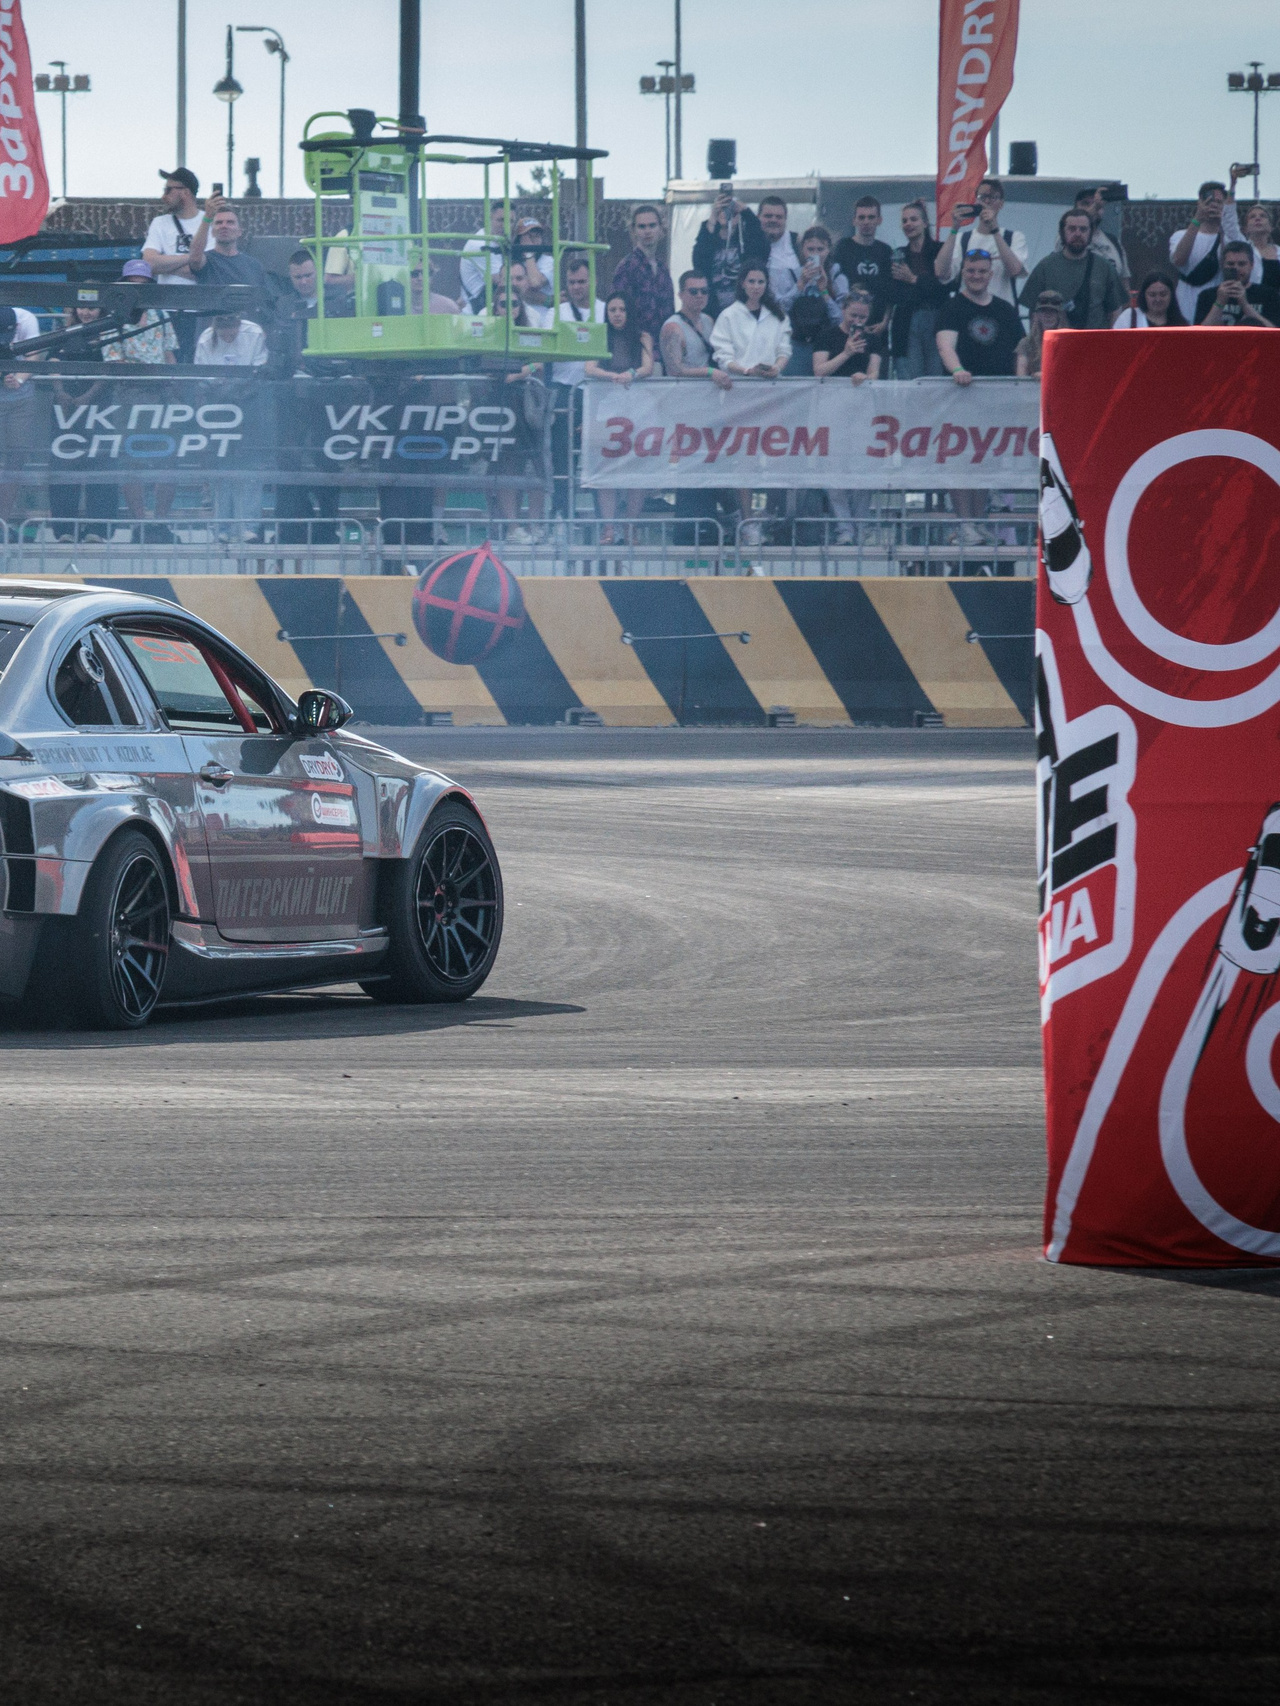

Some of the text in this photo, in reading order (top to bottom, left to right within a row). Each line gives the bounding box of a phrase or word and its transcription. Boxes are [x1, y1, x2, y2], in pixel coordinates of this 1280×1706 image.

[53, 403, 244, 430] VK ПРО
[325, 405, 517, 433] VK ПРО
[51, 433, 243, 459] СПОРТ
[323, 434, 516, 462] СПОРТ
[217, 867, 353, 919] ПИТЕРСКИЙ ЩИТ
